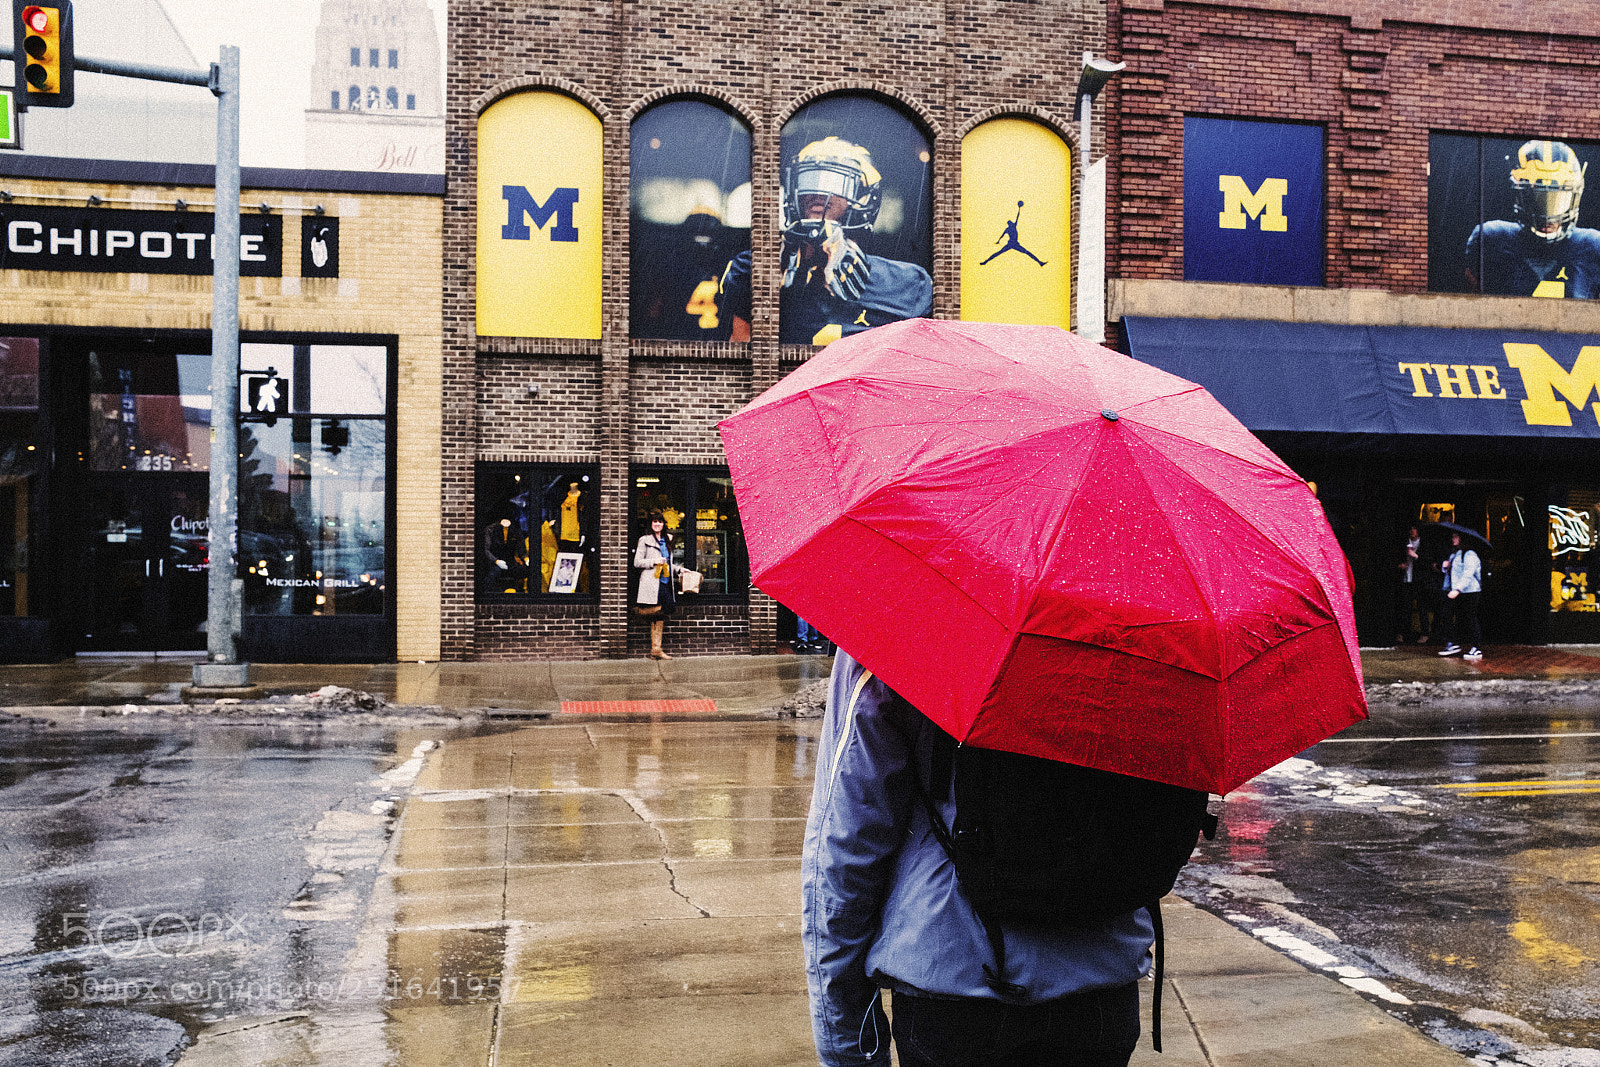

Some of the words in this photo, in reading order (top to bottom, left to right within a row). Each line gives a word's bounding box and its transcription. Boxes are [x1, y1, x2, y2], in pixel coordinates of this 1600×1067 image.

[501, 184, 580, 243] M
[1218, 174, 1288, 232] M
[8, 220, 267, 262] CHIPOTE
[1398, 361, 1508, 400] THE
[1502, 342, 1600, 427] M
[141, 455, 173, 471] 235
[170, 514, 209, 535] Chipot
[265, 577, 320, 588] MEXICAN
[323, 578, 360, 588] GRILL
